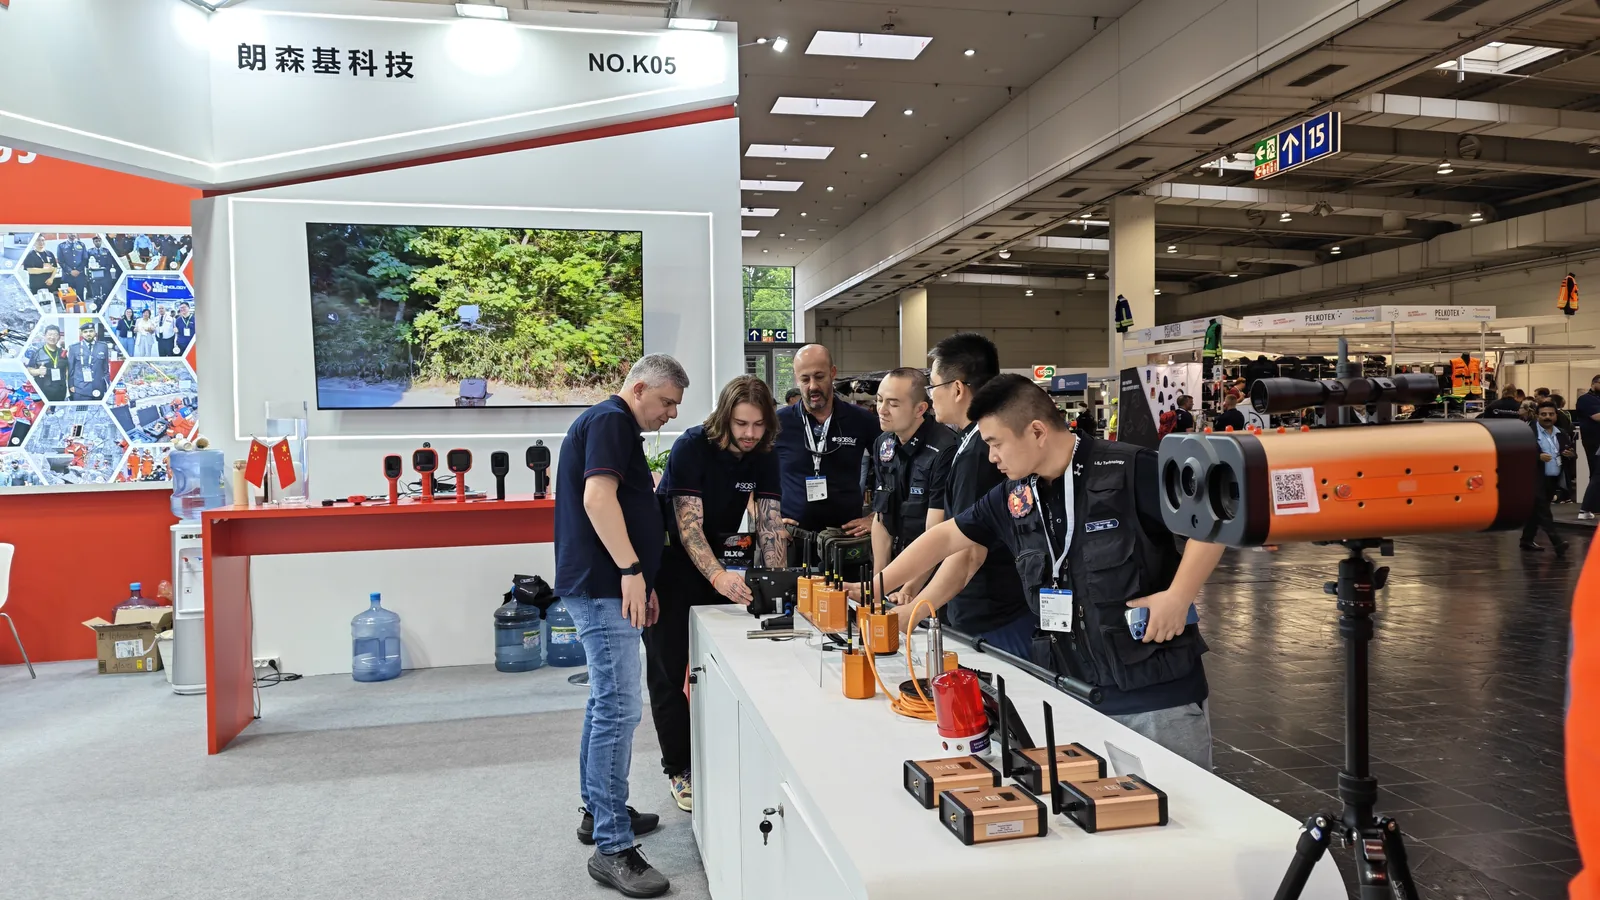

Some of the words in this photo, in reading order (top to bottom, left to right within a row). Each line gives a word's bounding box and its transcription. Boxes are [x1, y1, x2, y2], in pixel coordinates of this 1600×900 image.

[237, 43, 414, 79] 朗森基科技
[589, 53, 677, 75] NO.K05
[1308, 123, 1325, 149] 15
[1305, 313, 1336, 322] PELKOTEX
[1435, 309, 1460, 317] PELKOTEX
[775, 331, 787, 339] CC
